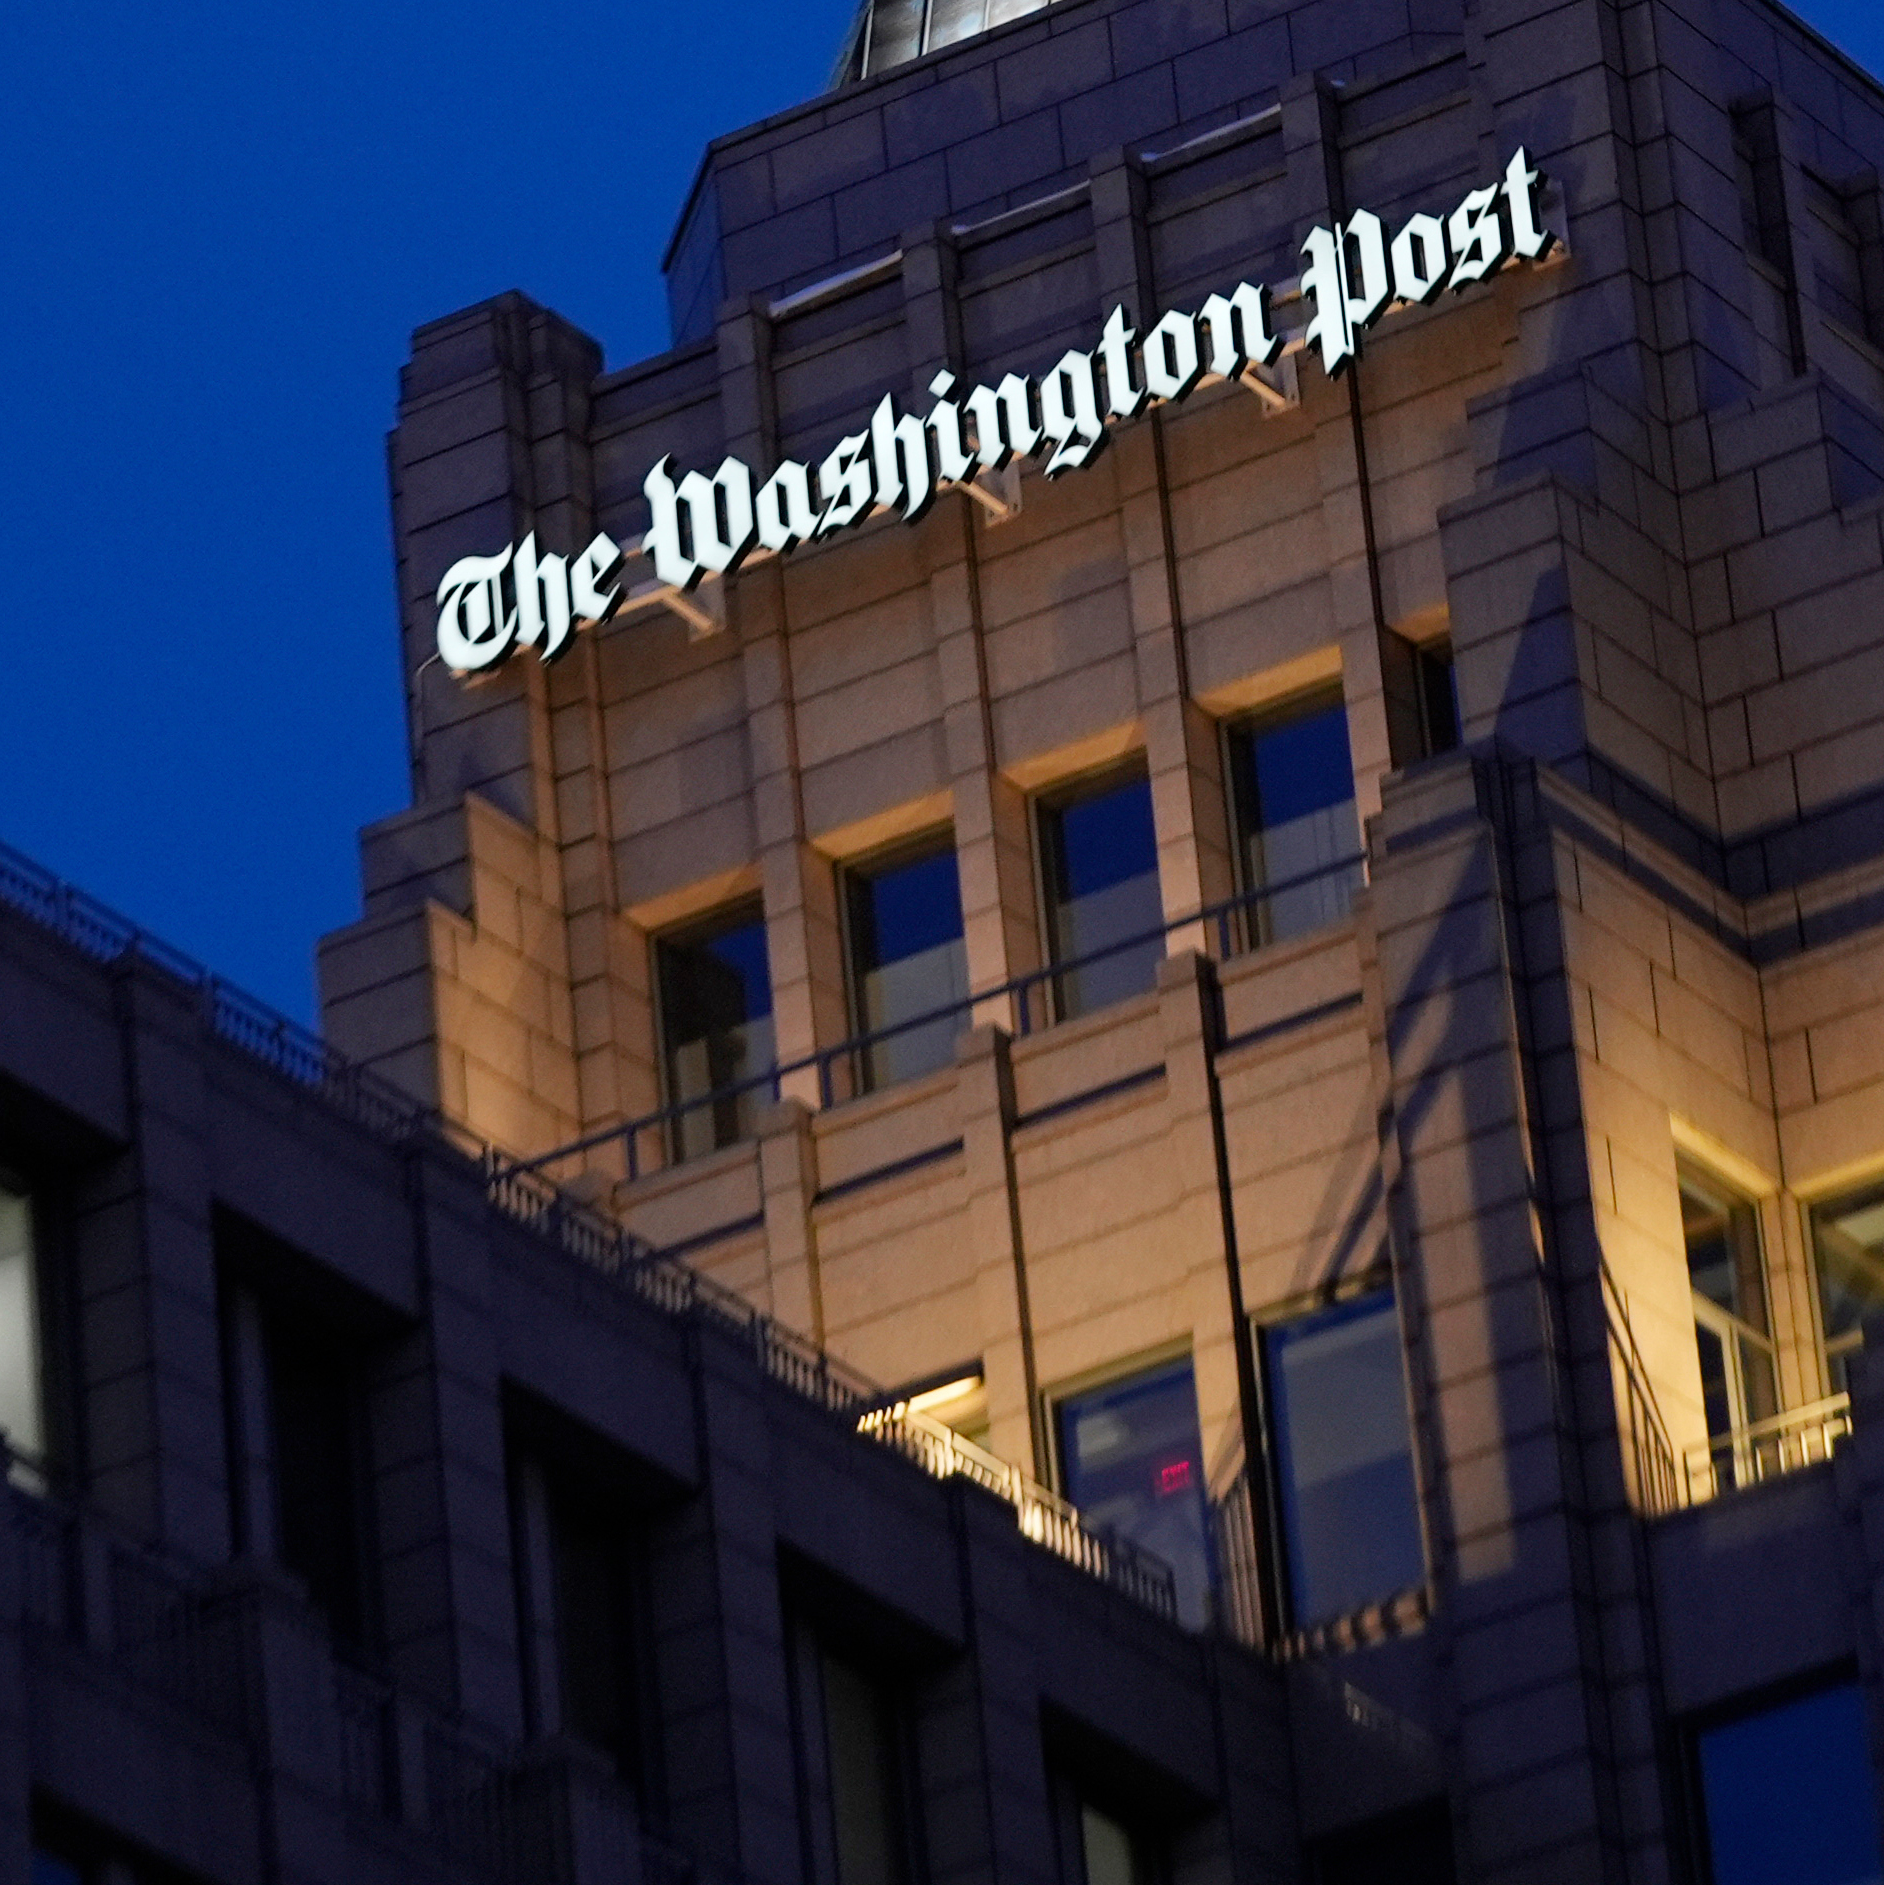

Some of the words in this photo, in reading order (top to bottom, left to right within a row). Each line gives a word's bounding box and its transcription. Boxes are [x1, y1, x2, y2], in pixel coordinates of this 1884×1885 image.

[436, 533, 622, 673] The
[644, 279, 1282, 590] Washington
[1301, 145, 1555, 378] Post
